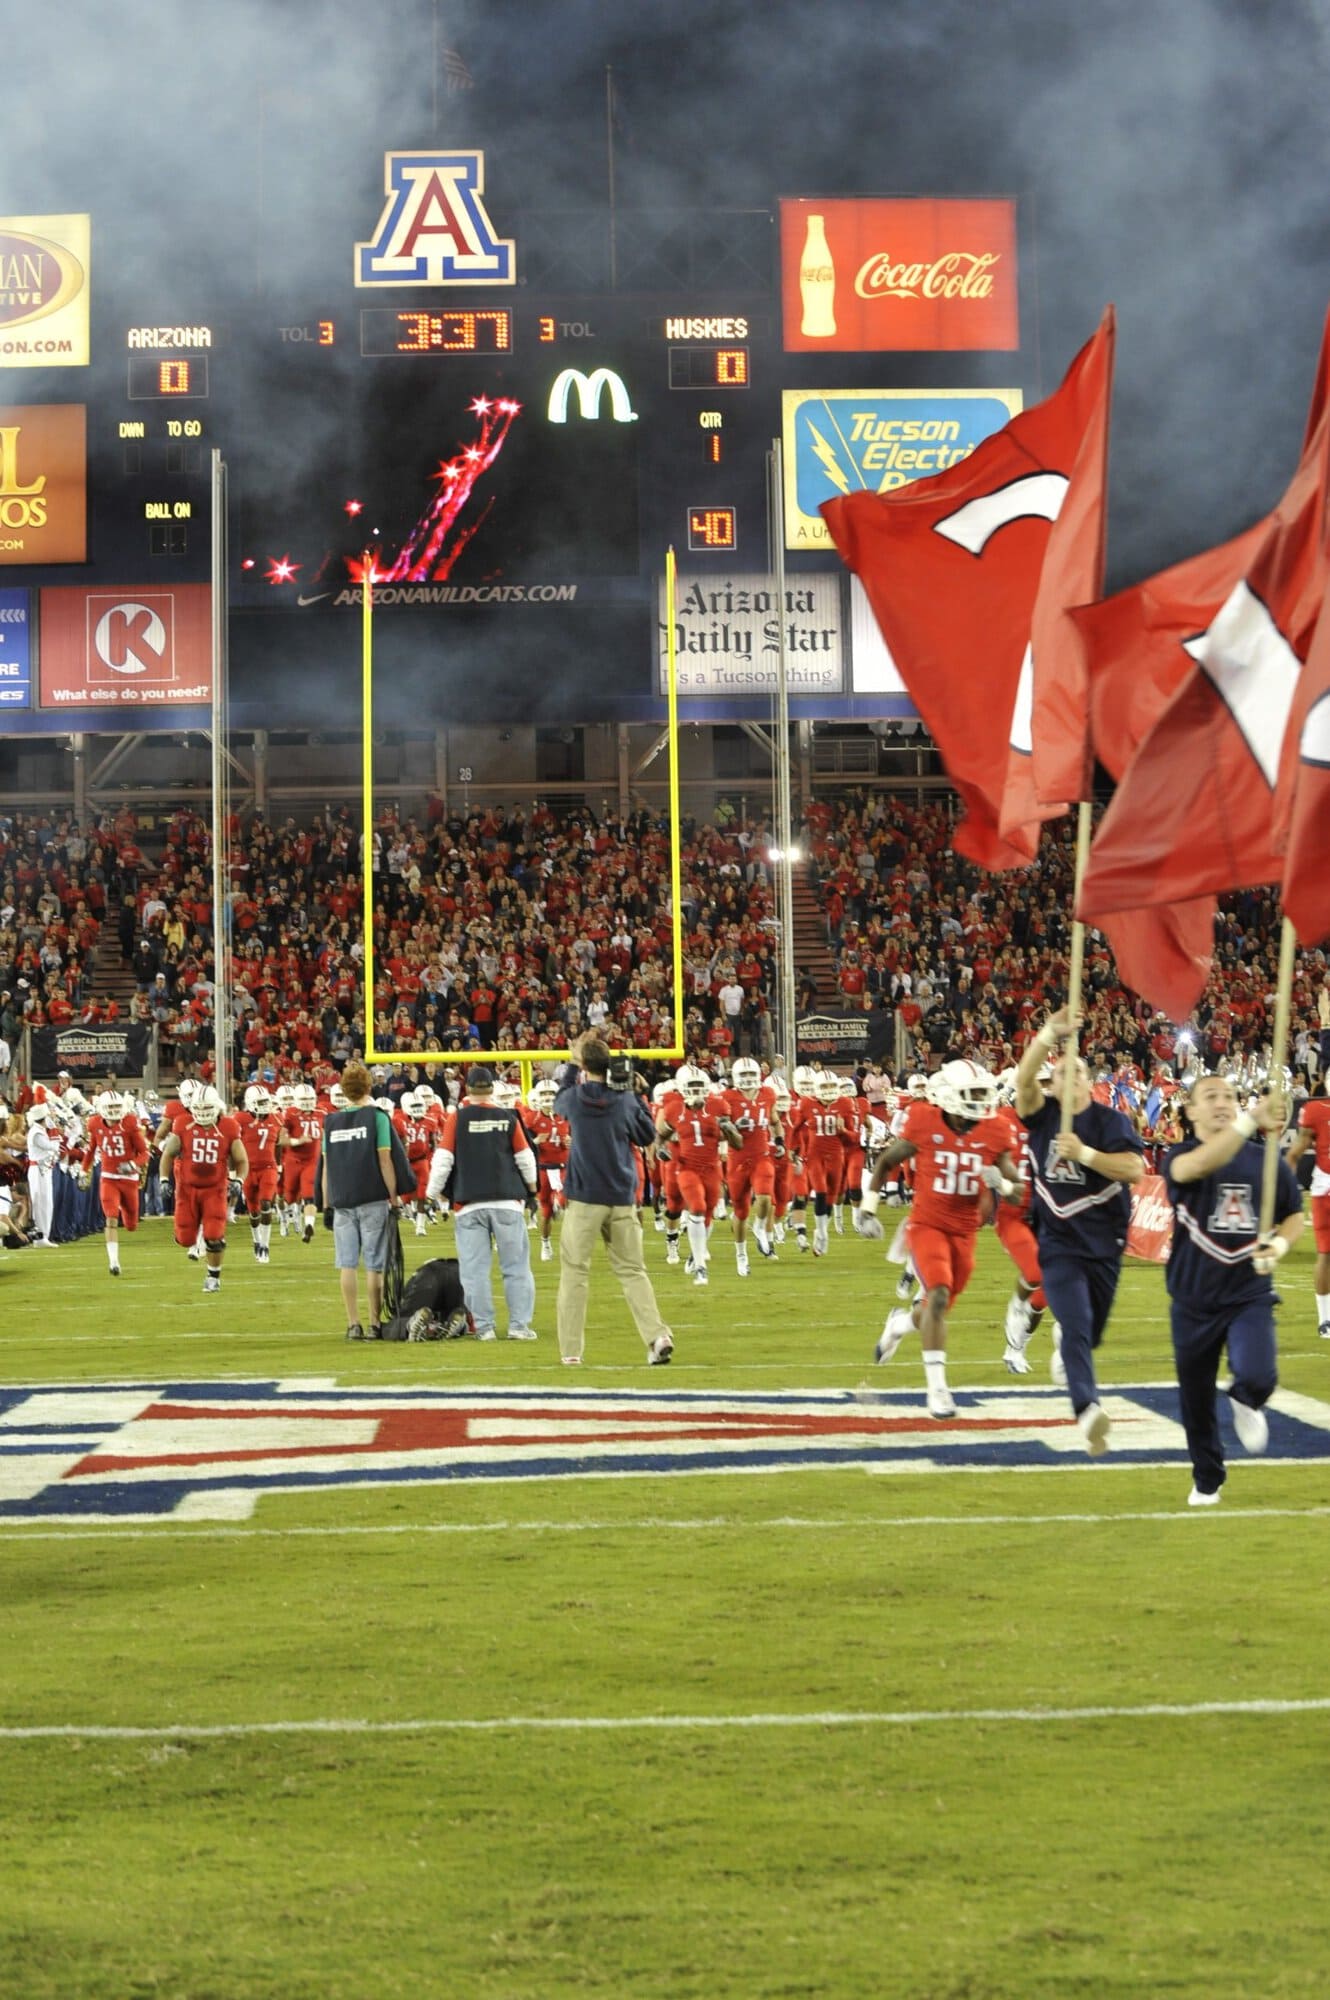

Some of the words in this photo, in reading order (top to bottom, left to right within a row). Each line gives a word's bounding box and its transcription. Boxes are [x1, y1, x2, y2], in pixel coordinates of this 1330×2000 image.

[354, 150, 516, 287] A
[854, 252, 1001, 299] Coca-Cola
[128, 328, 211, 348] ARIZONA
[279, 327, 313, 342] TOL
[319, 322, 333, 345] 3
[397, 312, 508, 349] 3:37
[540, 318, 554, 341] 3
[560, 322, 595, 337] TOL
[666, 318, 748, 339] HUSKIES
[0, 340, 72, 354] ON.COM
[160, 361, 188, 393] 0
[717, 352, 745, 383] 0
[119, 422, 144, 438] DWN
[167, 421, 182, 437] TO
[184, 420, 201, 436] GO
[700, 411, 722, 428] QTR
[850, 413, 960, 441] Tucson
[713, 435, 720, 462] 1
[861, 442, 976, 469] Electri
[0, 497, 47, 528] OS
[146, 503, 172, 519] BALL
[173, 502, 191, 518] ON
[692, 512, 732, 544] 40
[333, 584, 578, 606] ARZONAWILDCATS.COM
[107, 605, 164, 673] K
[658, 621, 752, 661] Daily
[761, 619, 838, 653] Star
[661, 668, 688, 684] I's
[695, 671, 706, 684] a
[712, 667, 778, 684] Tucson
[53, 690, 88, 701] What
[90, 688, 118, 700] else
[121, 687, 138, 700] do
[141, 690, 165, 701] you
[167, 686, 209, 699] need?
[798, 1023, 838, 1032] AMERICAN
[840, 1023, 868, 1031] FAMILY
[57, 1037, 97, 1045] AMERICAN
[98, 1037, 126, 1045] FAMILY
[330, 1126, 368, 1143] ESPN
[467, 1120, 510, 1133] ESPN
[690, 1120, 705, 1147] 1
[814, 1114, 837, 1136] 18
[102, 1135, 125, 1158] 43
[257, 1128, 269, 1150] 7
[192, 1138, 220, 1164] 55
[932, 1150, 984, 1196] 32
